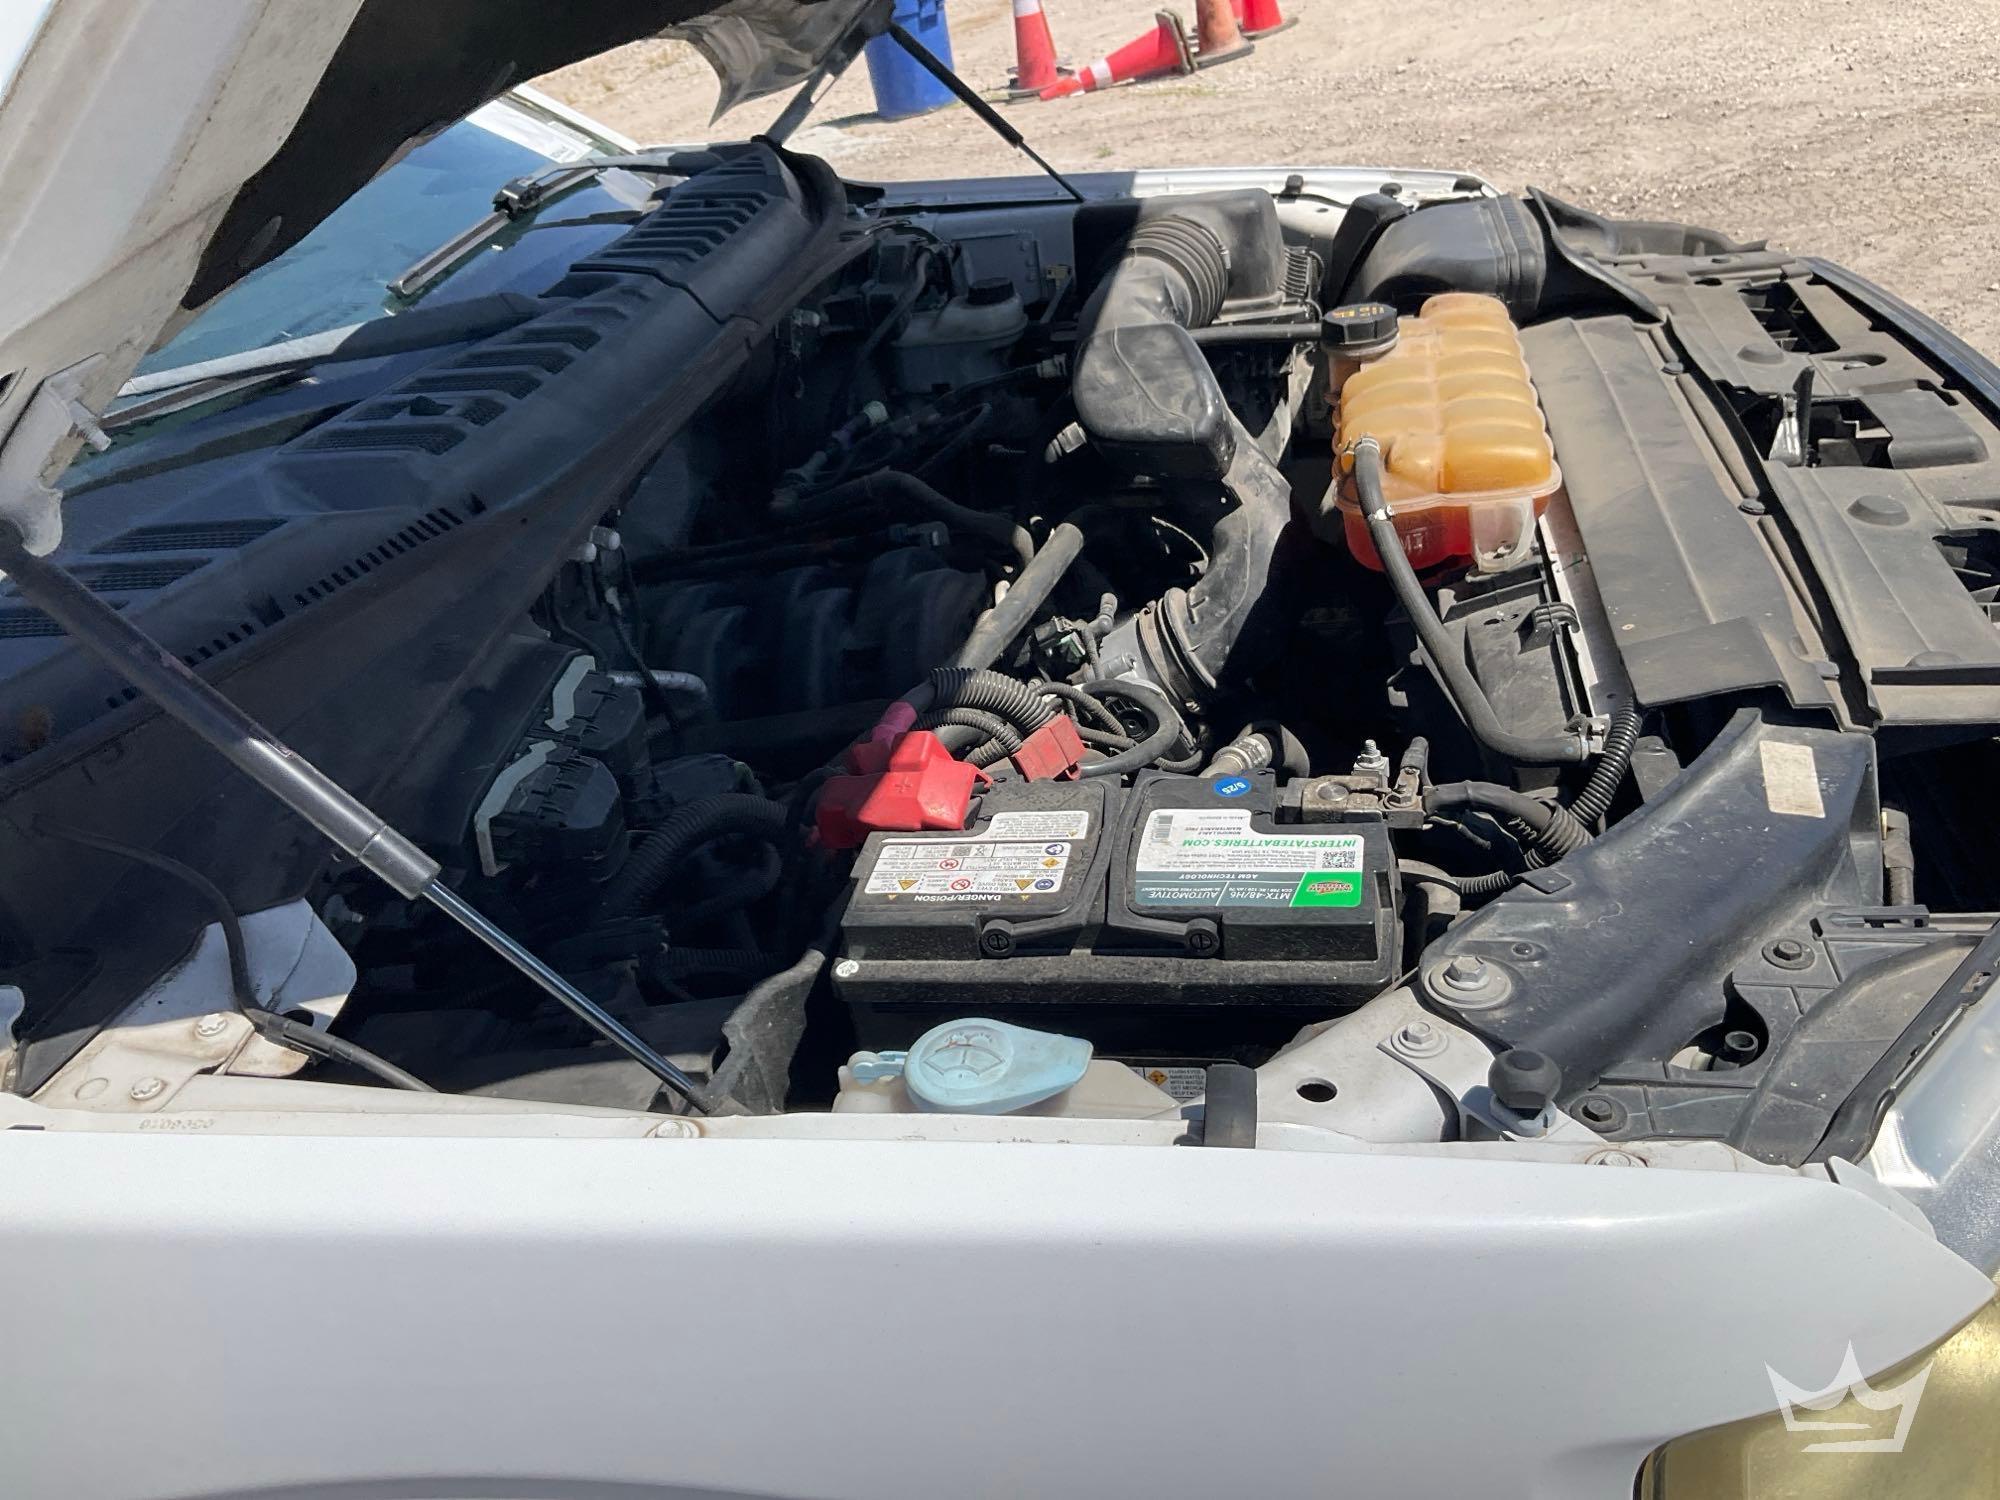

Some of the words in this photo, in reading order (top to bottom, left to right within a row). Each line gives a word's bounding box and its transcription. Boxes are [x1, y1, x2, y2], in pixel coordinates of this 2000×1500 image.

[1182, 839, 1356, 847] INTERSTATEBATTERIES.COM
[1148, 891, 1218, 899] AUTOMOTIVE
[1230, 891, 1291, 900] MTX-48/H6
